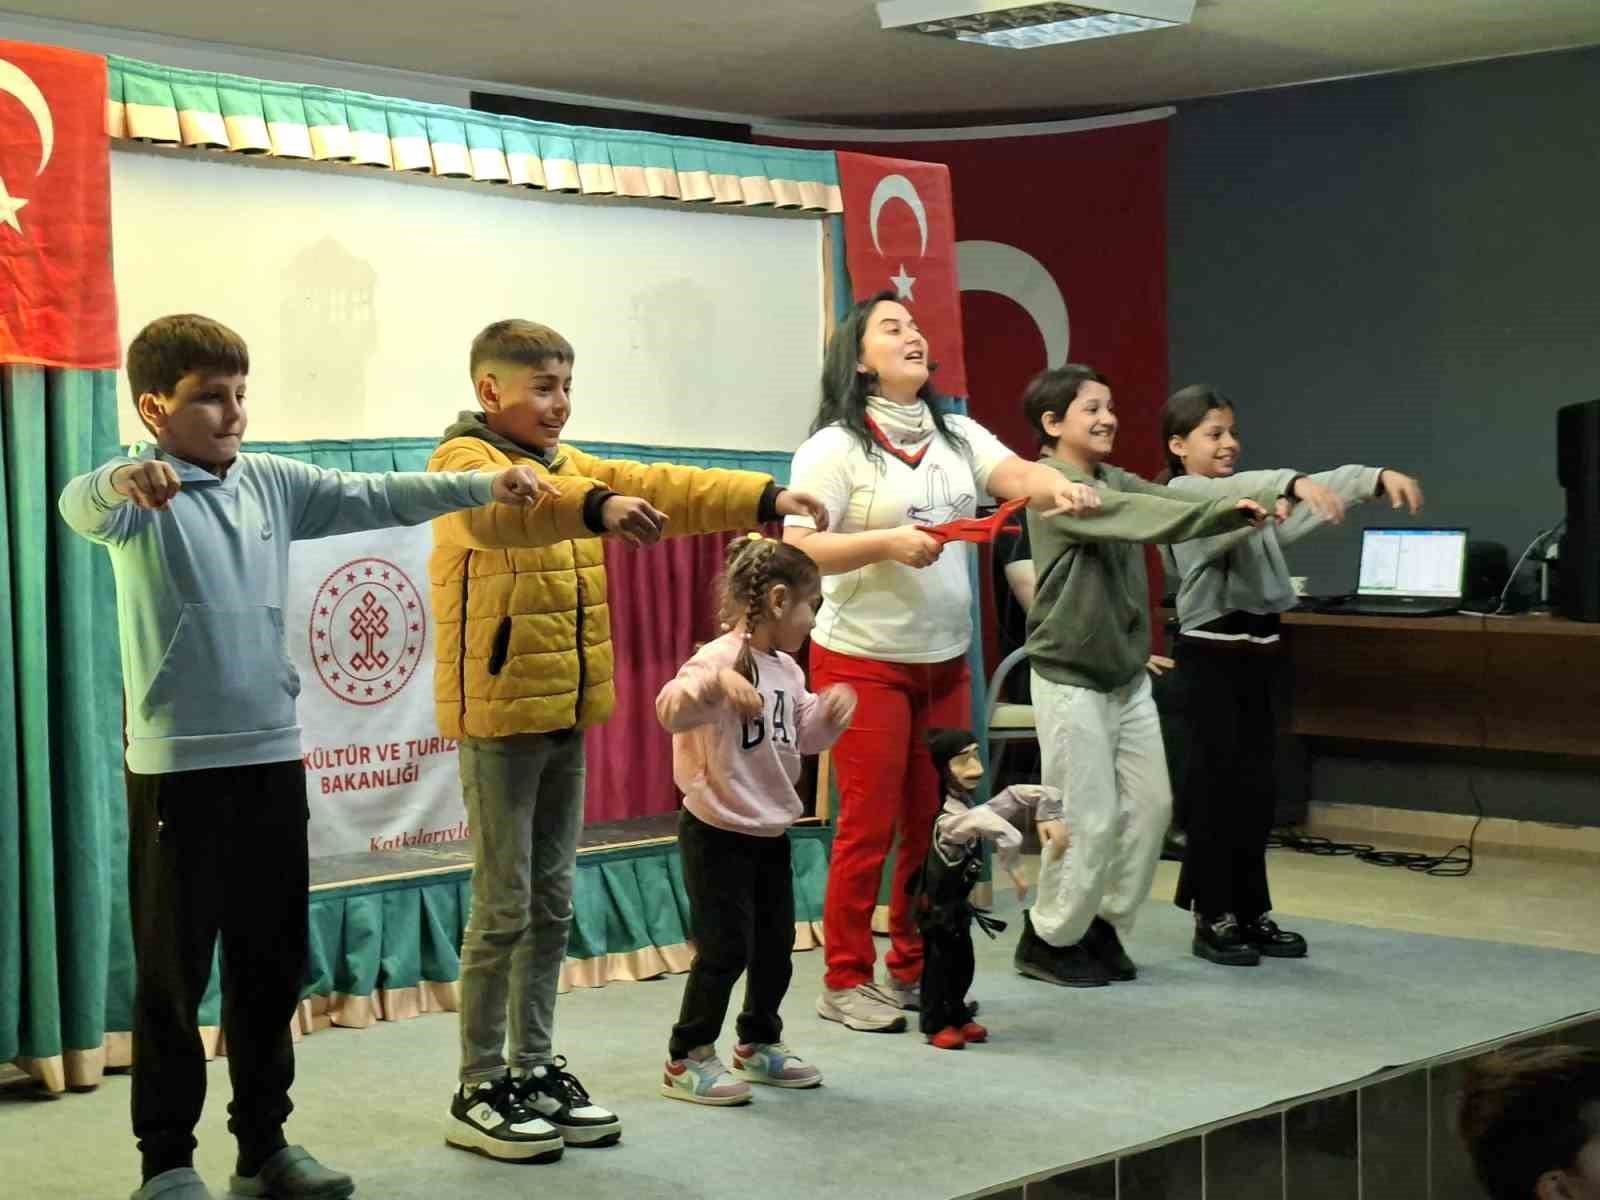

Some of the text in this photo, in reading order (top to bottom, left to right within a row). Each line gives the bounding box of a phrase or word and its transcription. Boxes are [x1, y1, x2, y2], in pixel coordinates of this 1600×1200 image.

[303, 744, 370, 770] KÜLTÜR
[376, 743, 401, 761] VE
[321, 762, 419, 794] BAKANLIĞI
